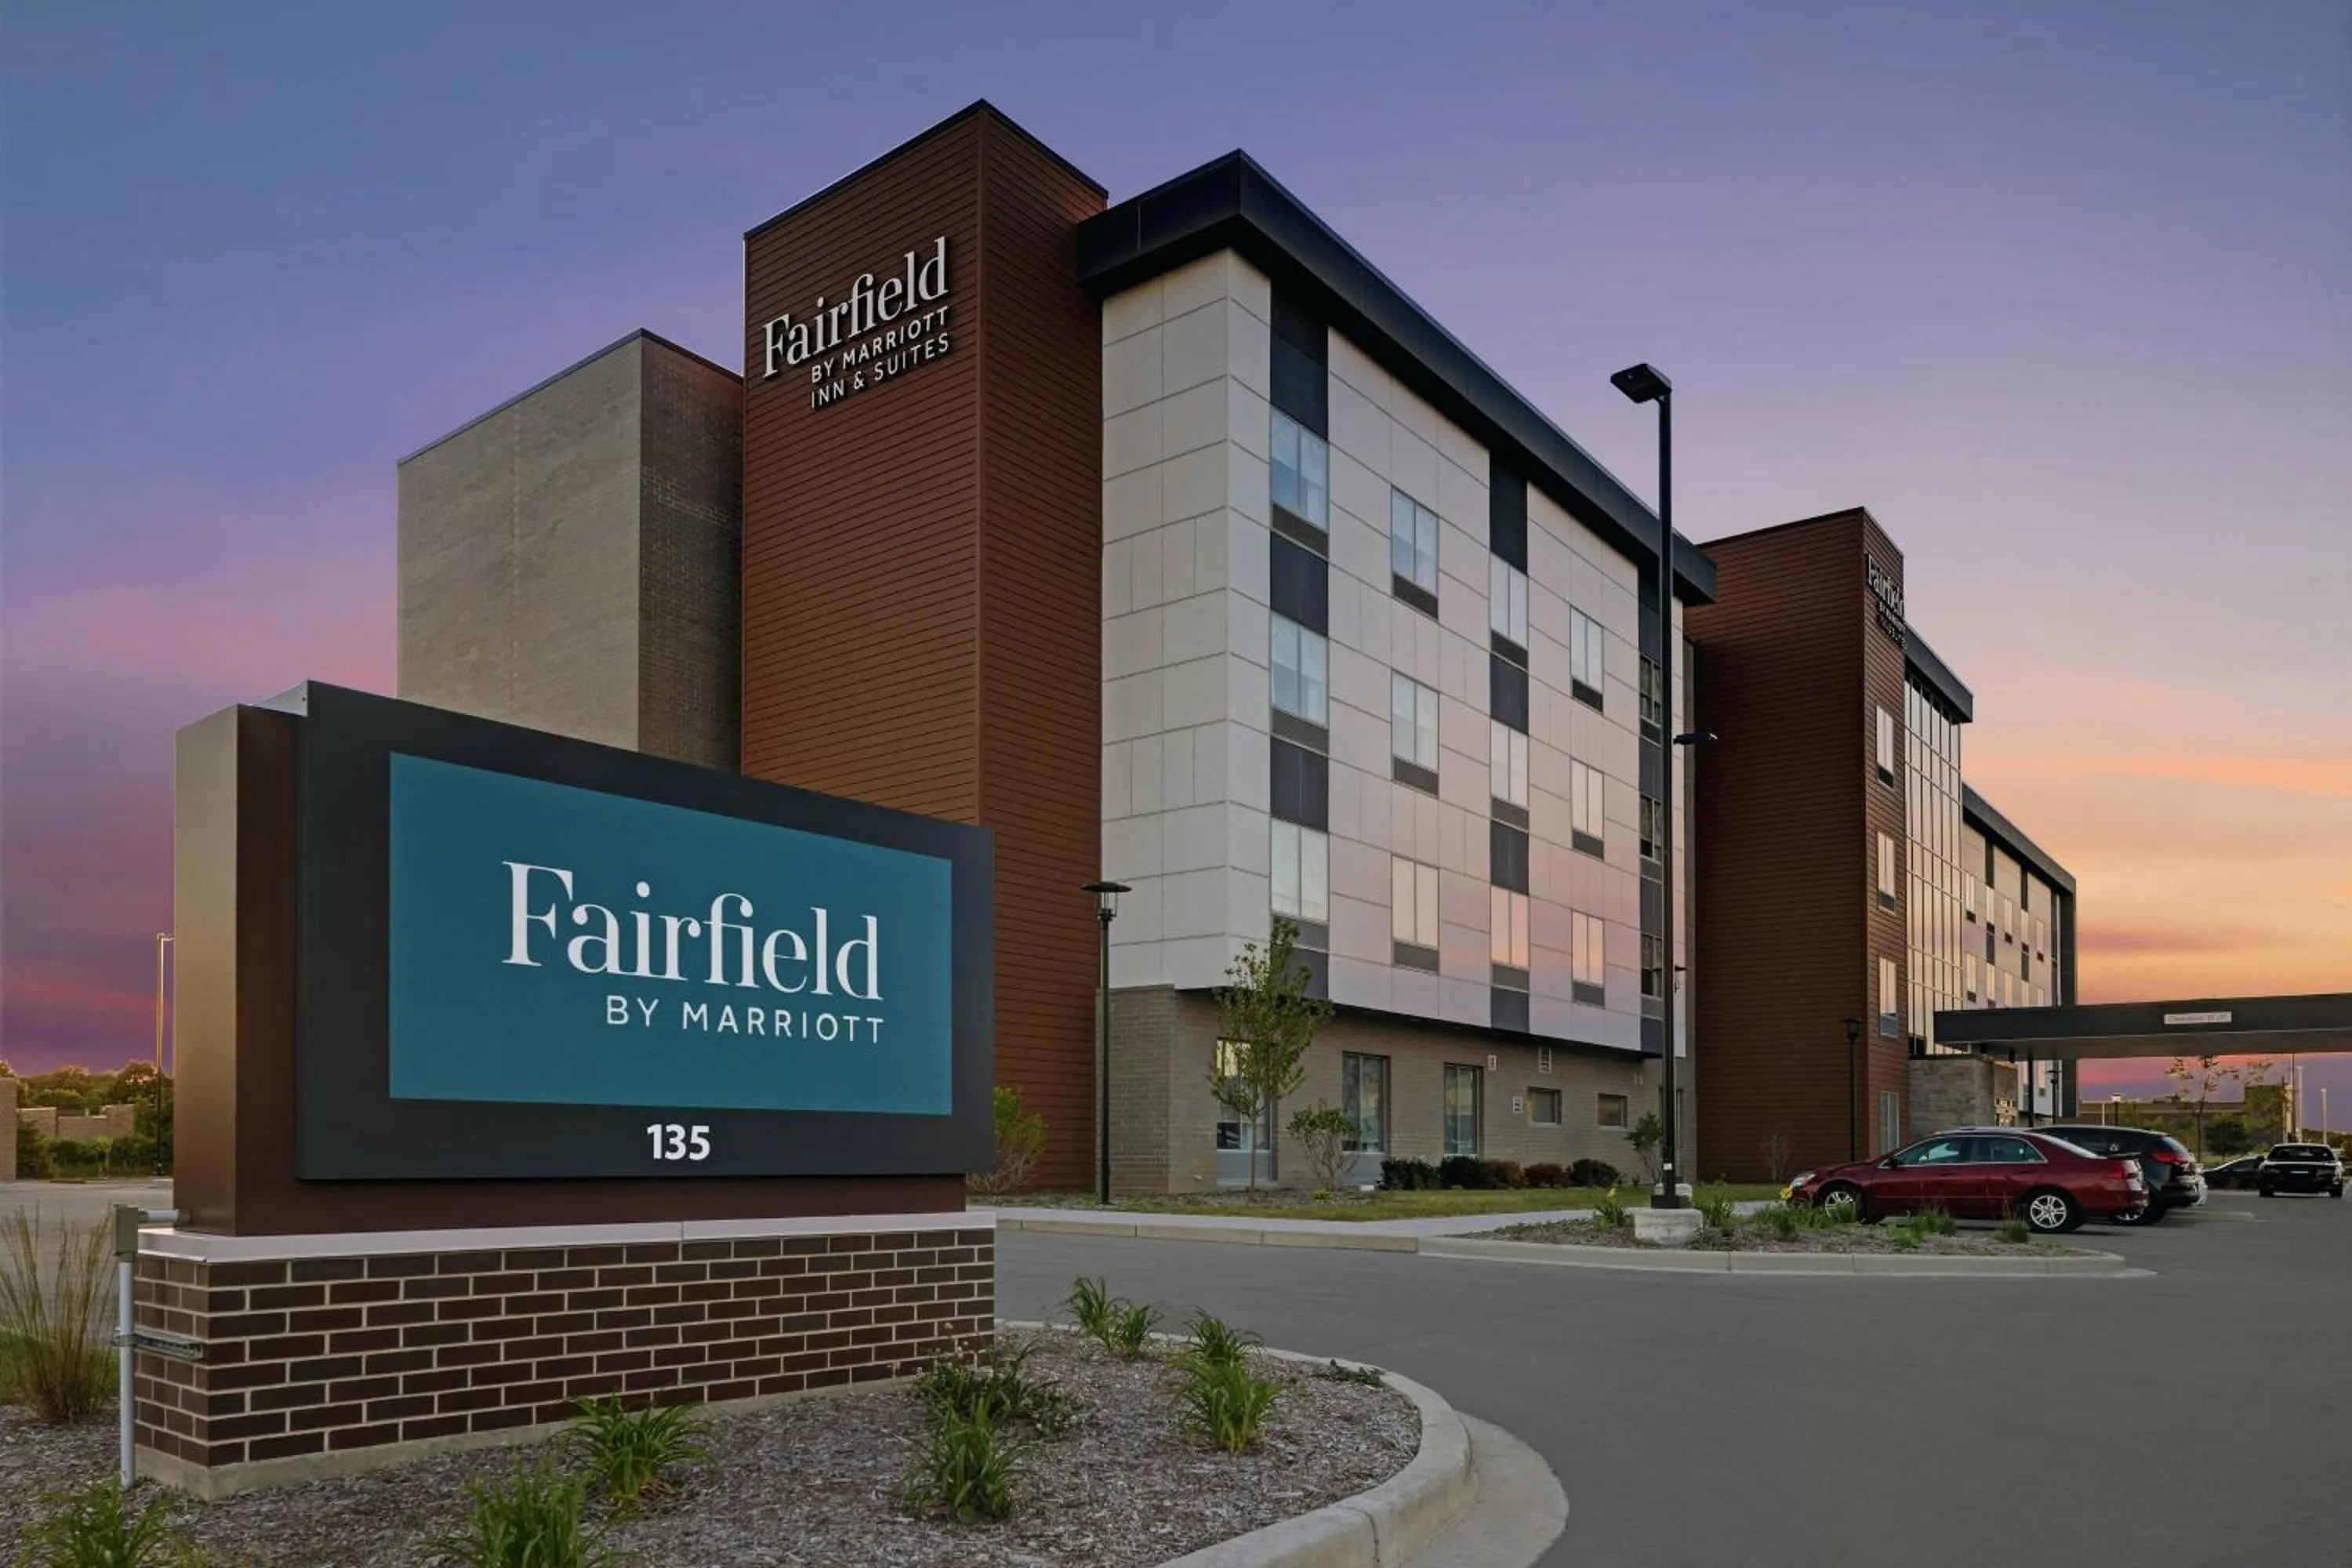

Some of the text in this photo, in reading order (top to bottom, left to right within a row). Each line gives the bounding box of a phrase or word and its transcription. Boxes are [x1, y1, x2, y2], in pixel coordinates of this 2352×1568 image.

[763, 236, 949, 378] Fairfield
[811, 306, 949, 383] BY MARRIOTT
[811, 332, 949, 408] INN & SUITES
[503, 861, 883, 1000] Fairfield
[607, 995, 884, 1044] BY MARRIOTT
[647, 1123, 710, 1161] 135
